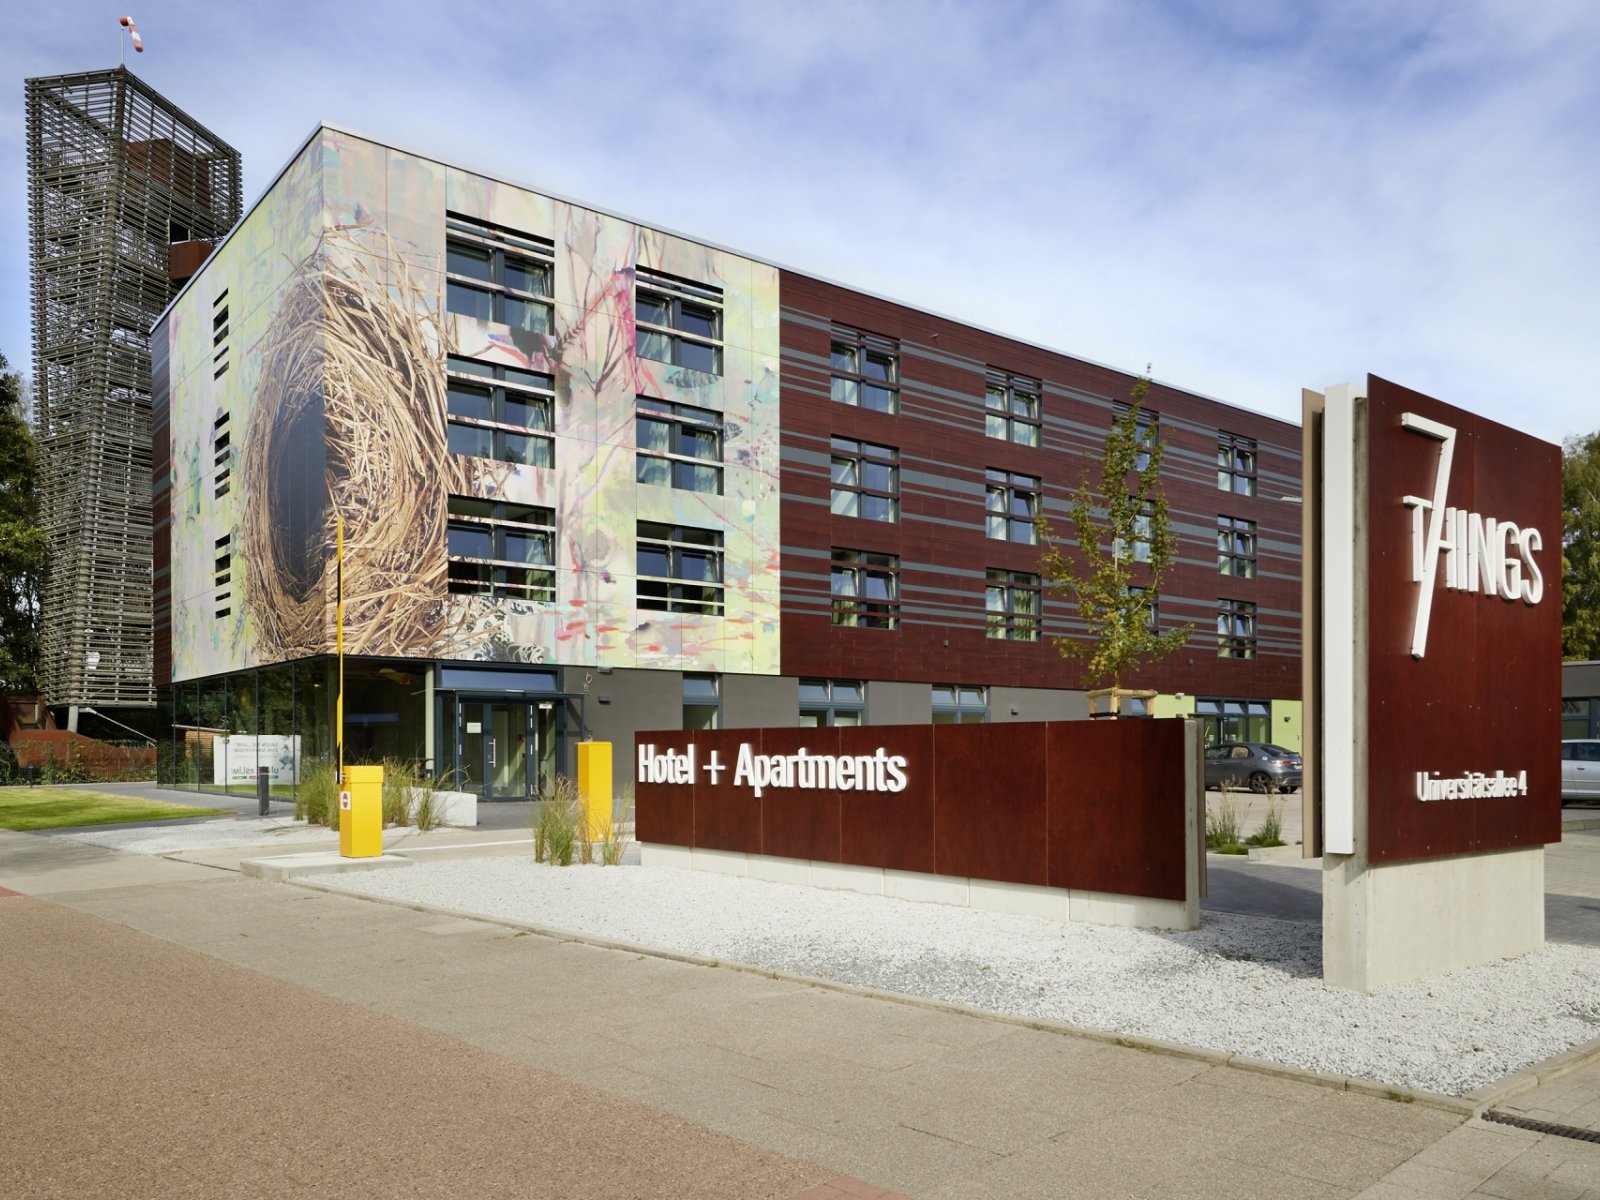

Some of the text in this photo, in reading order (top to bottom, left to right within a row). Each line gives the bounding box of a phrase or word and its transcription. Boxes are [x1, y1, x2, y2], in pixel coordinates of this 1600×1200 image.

[638, 744, 695, 785] Hotel
[733, 743, 907, 798] Apartments
[1518, 770, 1528, 796] 4
